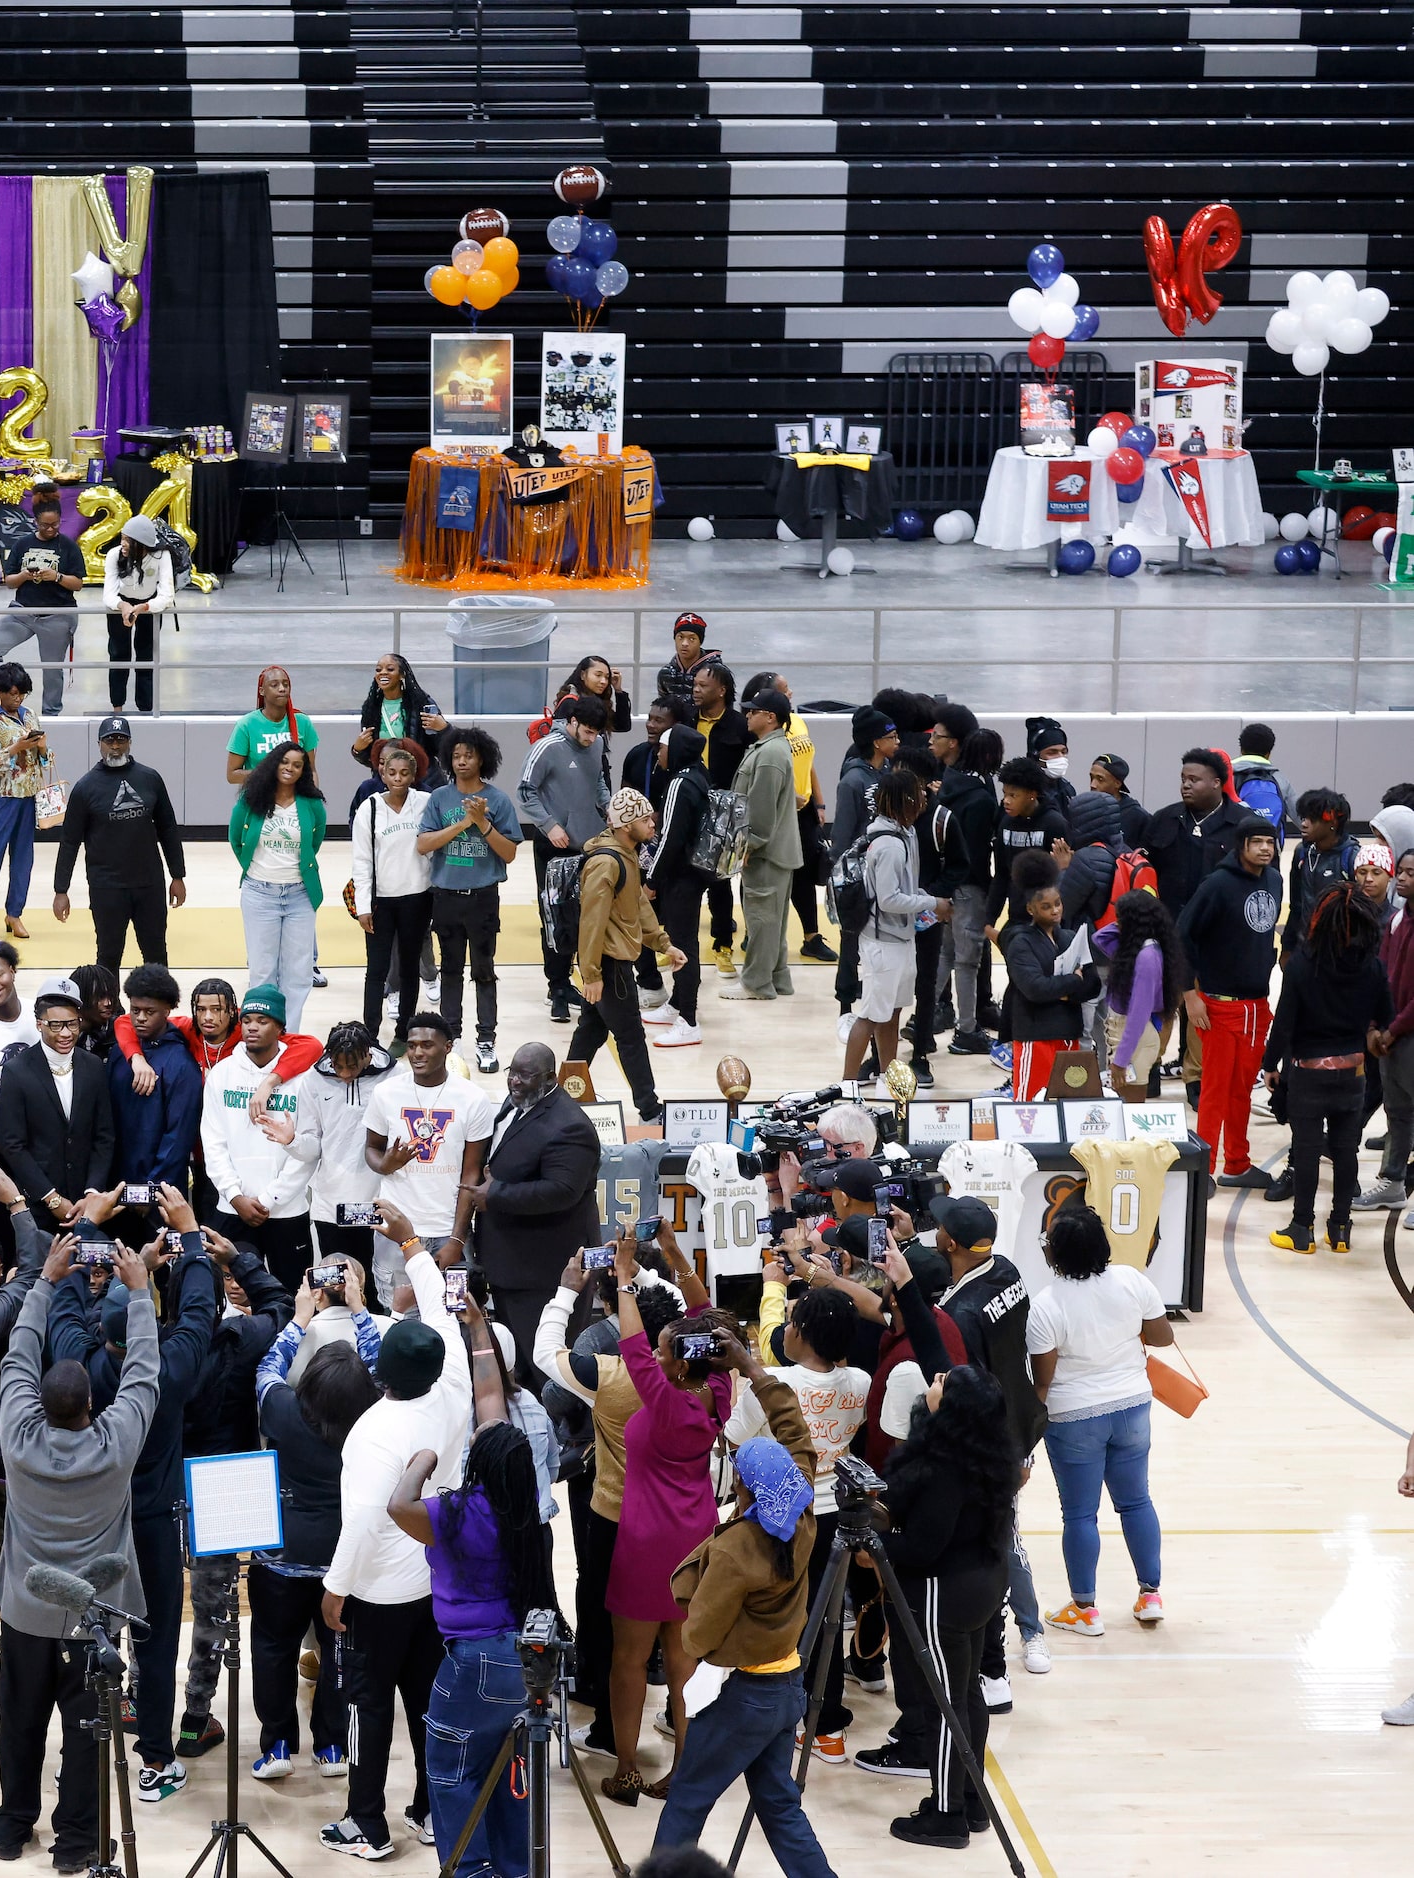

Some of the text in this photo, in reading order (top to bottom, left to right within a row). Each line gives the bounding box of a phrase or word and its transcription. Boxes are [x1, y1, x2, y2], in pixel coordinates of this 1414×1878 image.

[460, 445, 488, 454] MINERS
[513, 468, 578, 498] UTEP UTEP
[626, 478, 651, 506] UTEP
[1050, 502, 1088, 511] UTAH TECH
[382, 825, 401, 837] NORTH
[263, 840, 301, 849] MEAN GREE
[460, 841, 488, 858] TEXAS
[266, 1093, 297, 1113] EXAS
[689, 1109, 718, 1120] TLU
[1145, 1113, 1177, 1126] UNT
[593, 1120, 616, 1128] STERN
[1082, 1123, 1107, 1131] UTEP
[1115, 1169, 1136, 1180] SOC
[714, 1186, 759, 1197] THE MECCA
[965, 1181, 1012, 1191] THE MECCA
[596, 1178, 641, 1225] 15
[1109, 1183, 1140, 1235] 0
[713, 1200, 756, 1249] 10
[983, 1297, 1006, 1324] THE
[837, 1391, 865, 1410] the
